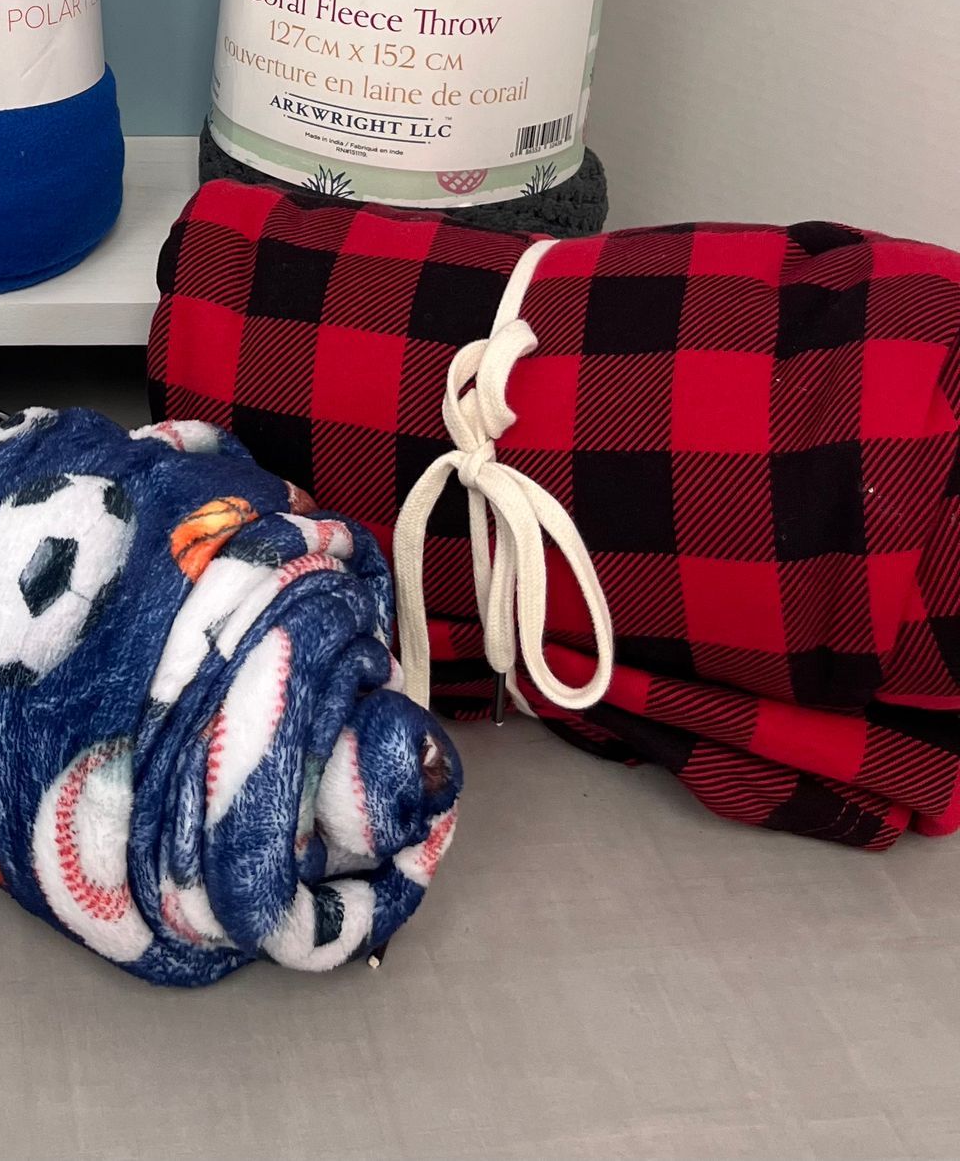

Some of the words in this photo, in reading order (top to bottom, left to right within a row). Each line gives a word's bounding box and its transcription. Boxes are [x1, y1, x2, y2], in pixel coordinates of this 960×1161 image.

[414, 7, 502, 36] Throw
[224, 35, 317, 87] couverture
[325, 76, 354, 97] en
[362, 76, 423, 106] laine
[431, 83, 462, 106] de
[469, 77, 528, 105] corail
[374, 42, 416, 70] 152
[270, 95, 402, 135] ARKWRIGHT
[410, 123, 452, 138] LLC
[305, 131, 321, 141] Made
[329, 138, 344, 146] India
